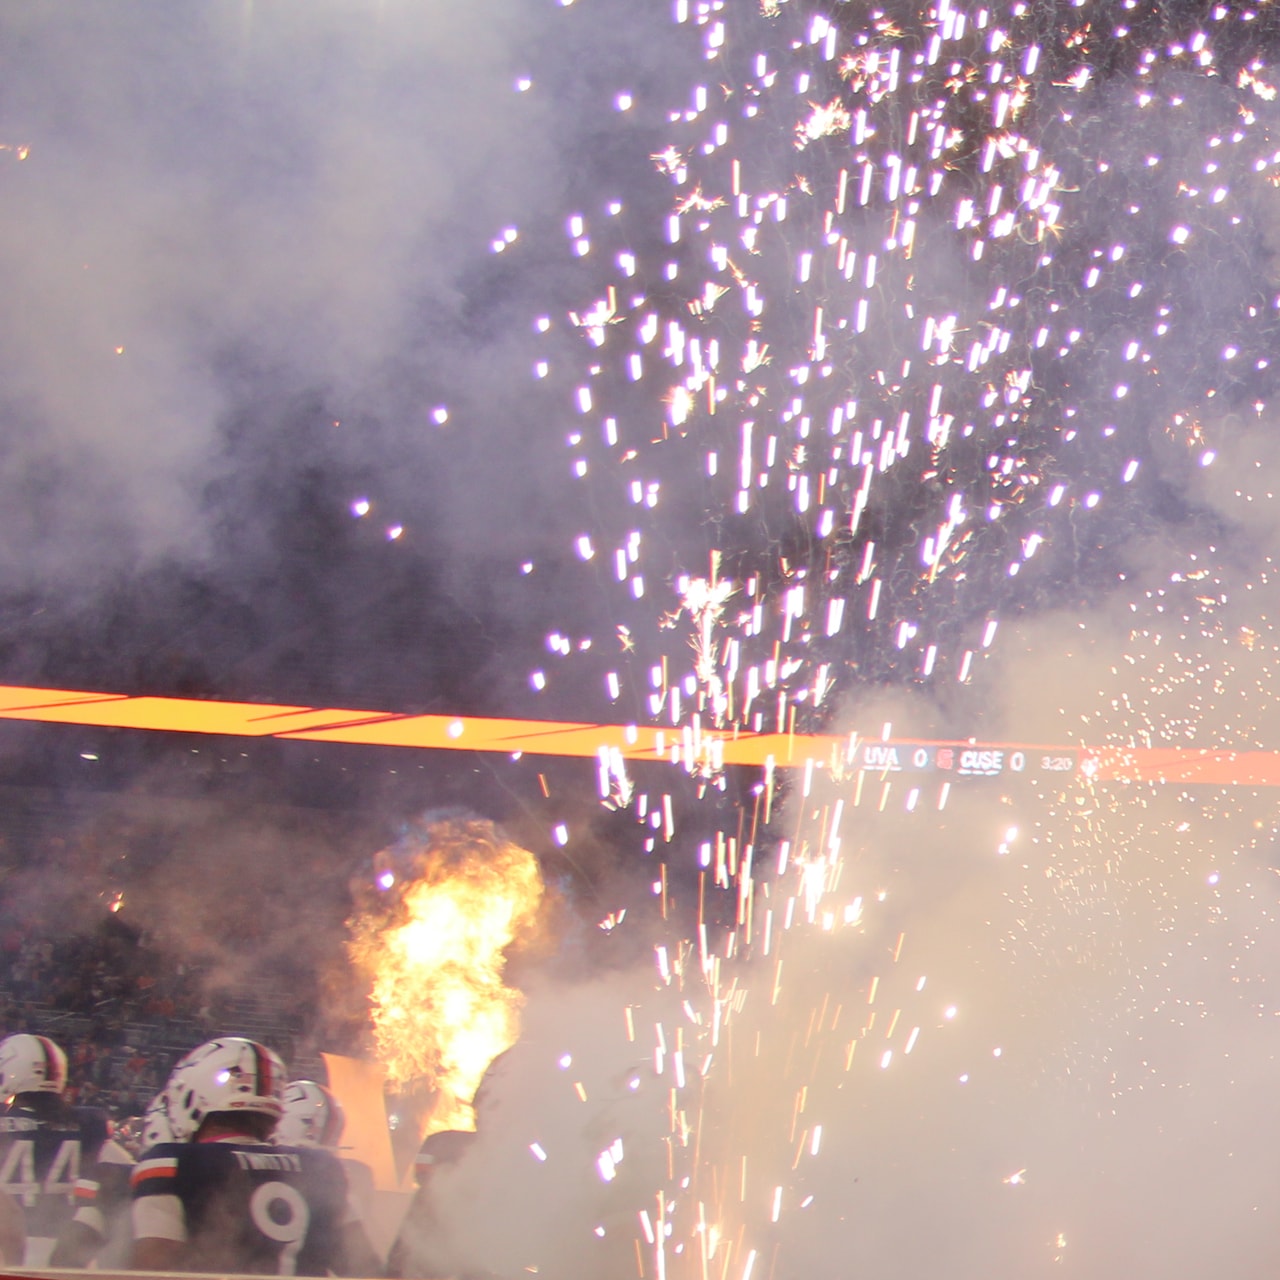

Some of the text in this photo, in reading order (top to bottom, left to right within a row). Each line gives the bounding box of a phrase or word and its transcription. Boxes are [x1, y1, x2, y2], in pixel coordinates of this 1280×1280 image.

[863, 746, 899, 766] UVA
[914, 748, 928, 768] 0
[960, 750, 1003, 770] CUSE
[1010, 752, 1025, 771] 0
[0, 1140, 82, 1207] 44
[249, 1180, 310, 1276] 9
